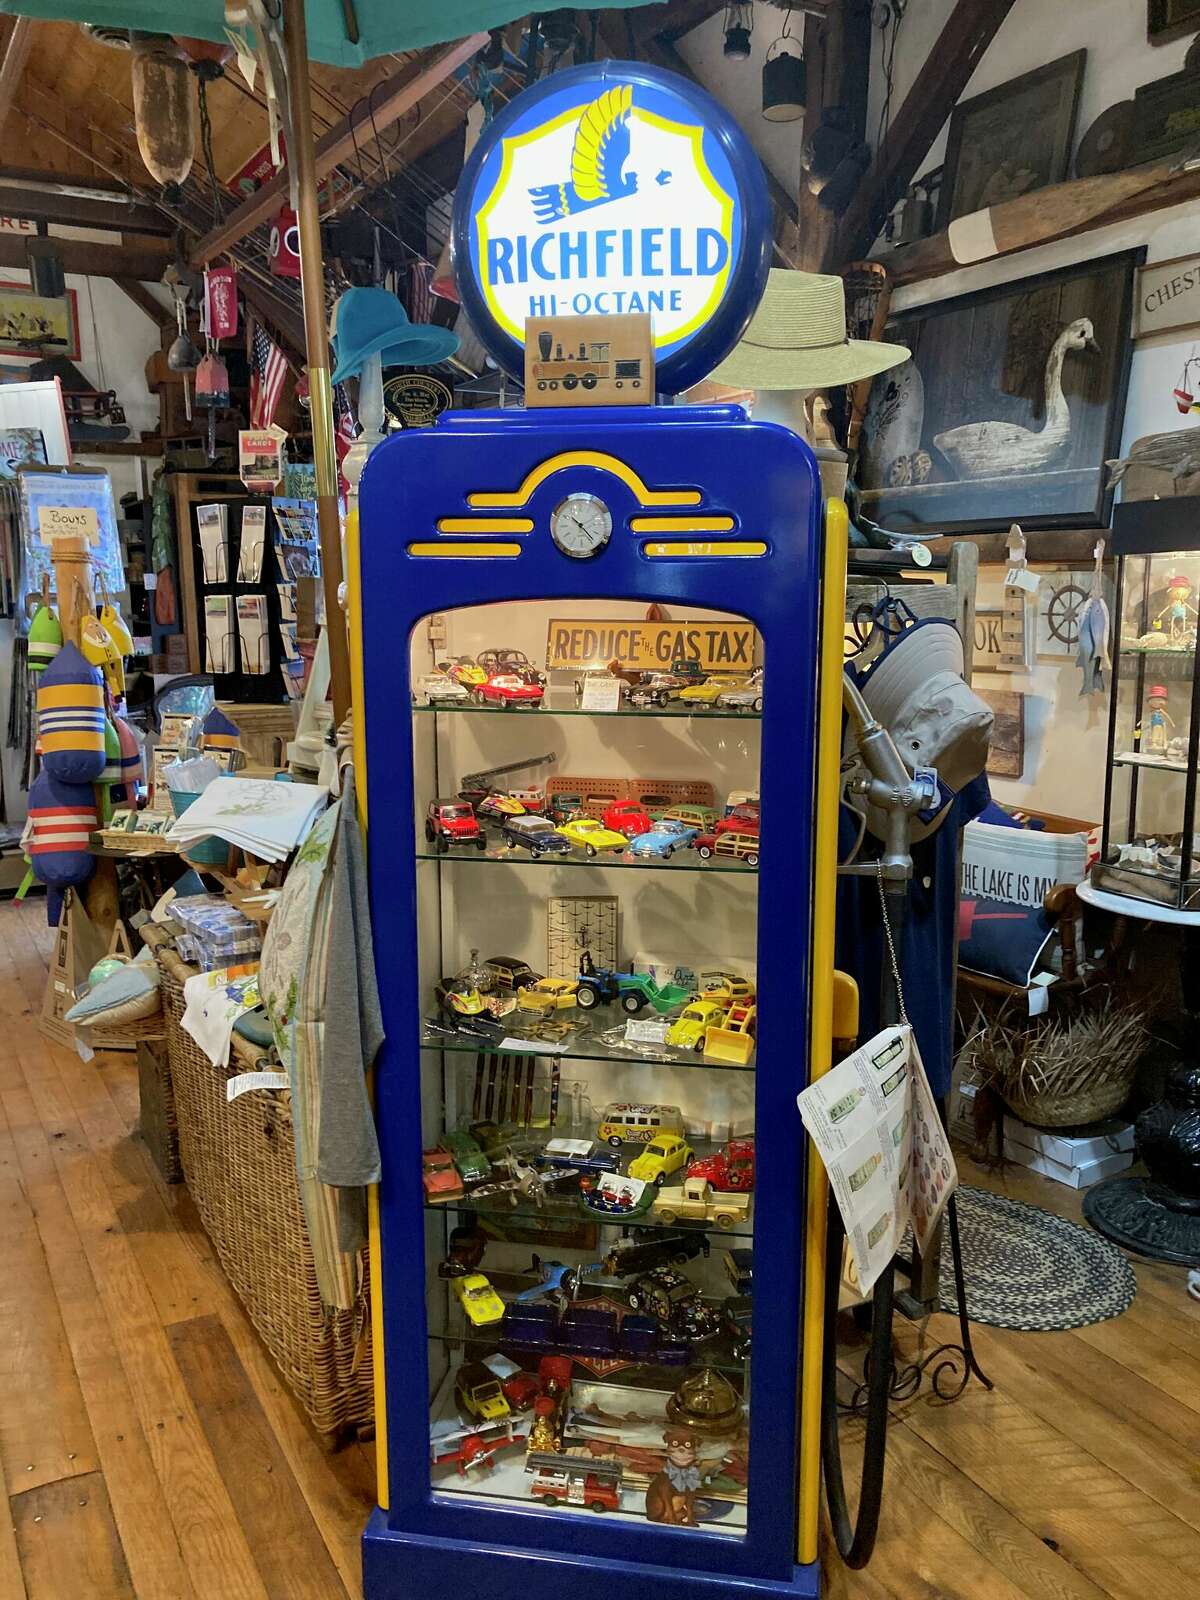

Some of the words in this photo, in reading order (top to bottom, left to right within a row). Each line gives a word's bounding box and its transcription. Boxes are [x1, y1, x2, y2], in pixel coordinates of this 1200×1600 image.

[487, 228, 729, 286] RICHFIELD
[528, 290, 683, 317] HI-OCTANE
[554, 628, 642, 661] REDUCE
[641, 637, 654, 657] THE
[655, 630, 701, 663] GAS
[705, 631, 750, 663] TAX
[962, 862, 979, 891] HE
[982, 866, 1015, 899] LAKE
[1018, 874, 1030, 901] IS
